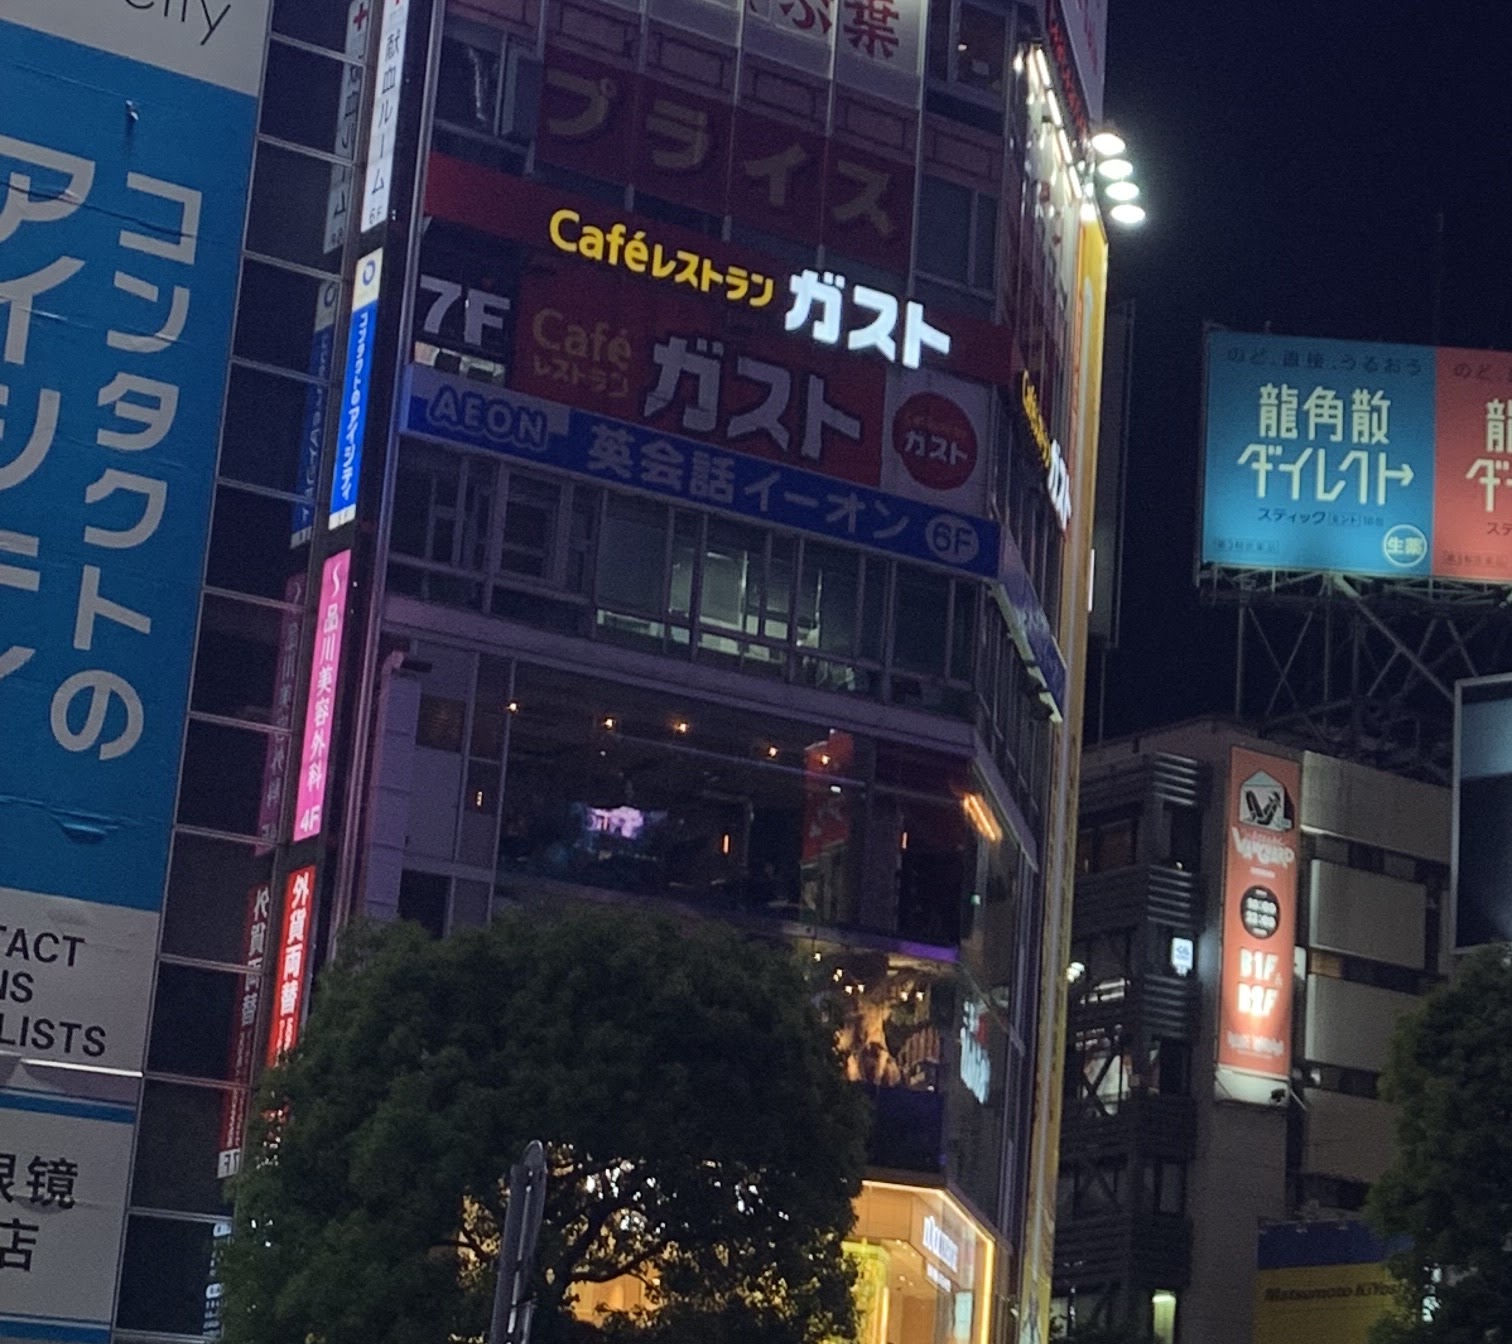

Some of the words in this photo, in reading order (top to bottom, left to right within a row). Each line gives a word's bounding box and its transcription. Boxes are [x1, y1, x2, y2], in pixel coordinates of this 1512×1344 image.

[417, 272, 512, 347] 7F
[783, 267, 952, 370] ガスト
[427, 385, 551, 452] AEON
[641, 335, 863, 459] ガスト
[1258, 382, 1393, 446] 龍角散
[49, 170, 204, 761] コンタクトの
[904, 427, 969, 467] ガスト
[1237, 442, 1415, 506] ダイレクト
[587, 422, 909, 541] 英会話イーオン
[931, 520, 974, 555] 6F
[300, 804, 321, 832] 4F
